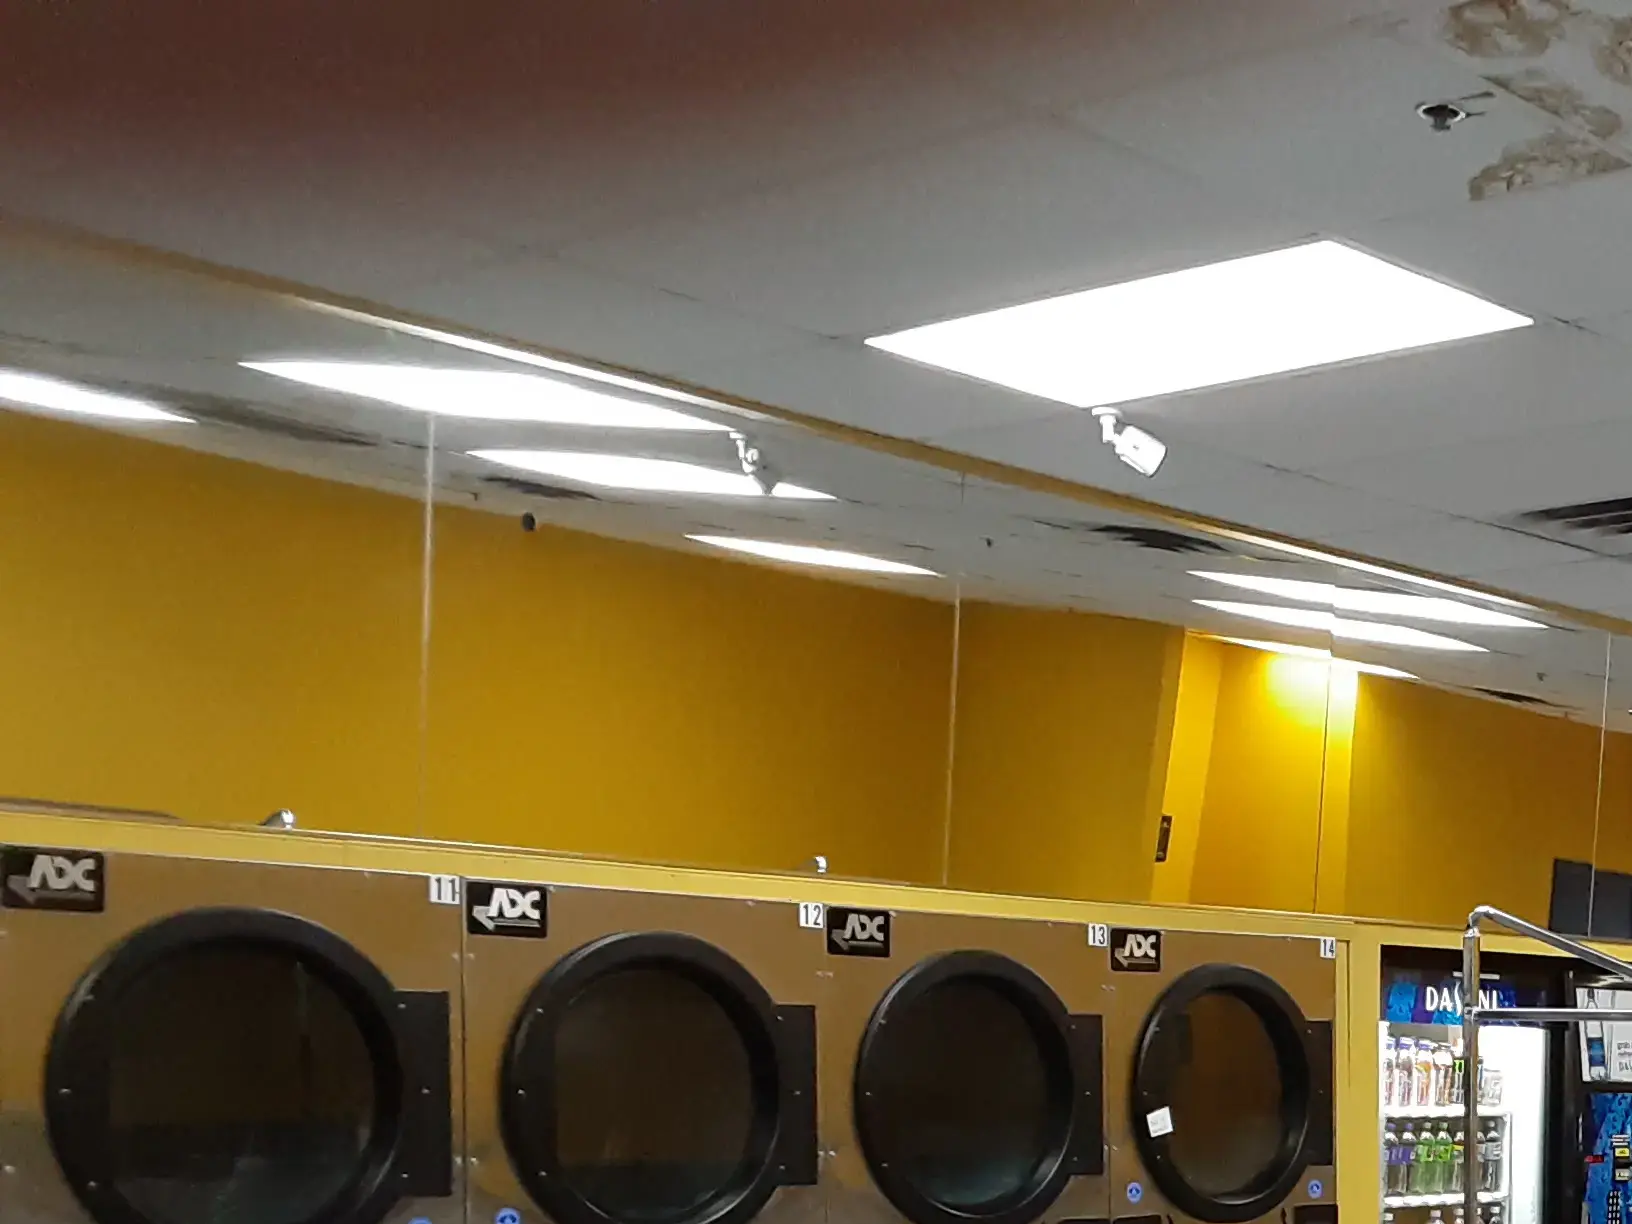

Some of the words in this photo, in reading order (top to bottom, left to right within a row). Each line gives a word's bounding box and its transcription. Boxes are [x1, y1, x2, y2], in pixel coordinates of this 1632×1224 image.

[27, 854, 96, 892] ADC
[434, 876, 456, 902] 11
[487, 887, 541, 920] ADC
[802, 903, 822, 926] 12
[842, 913, 885, 942] ADC
[1090, 926, 1106, 945] 13
[1123, 933, 1157, 958] ADC
[1323, 940, 1335, 956] 14
[1425, 986, 1497, 1014] DASNI
